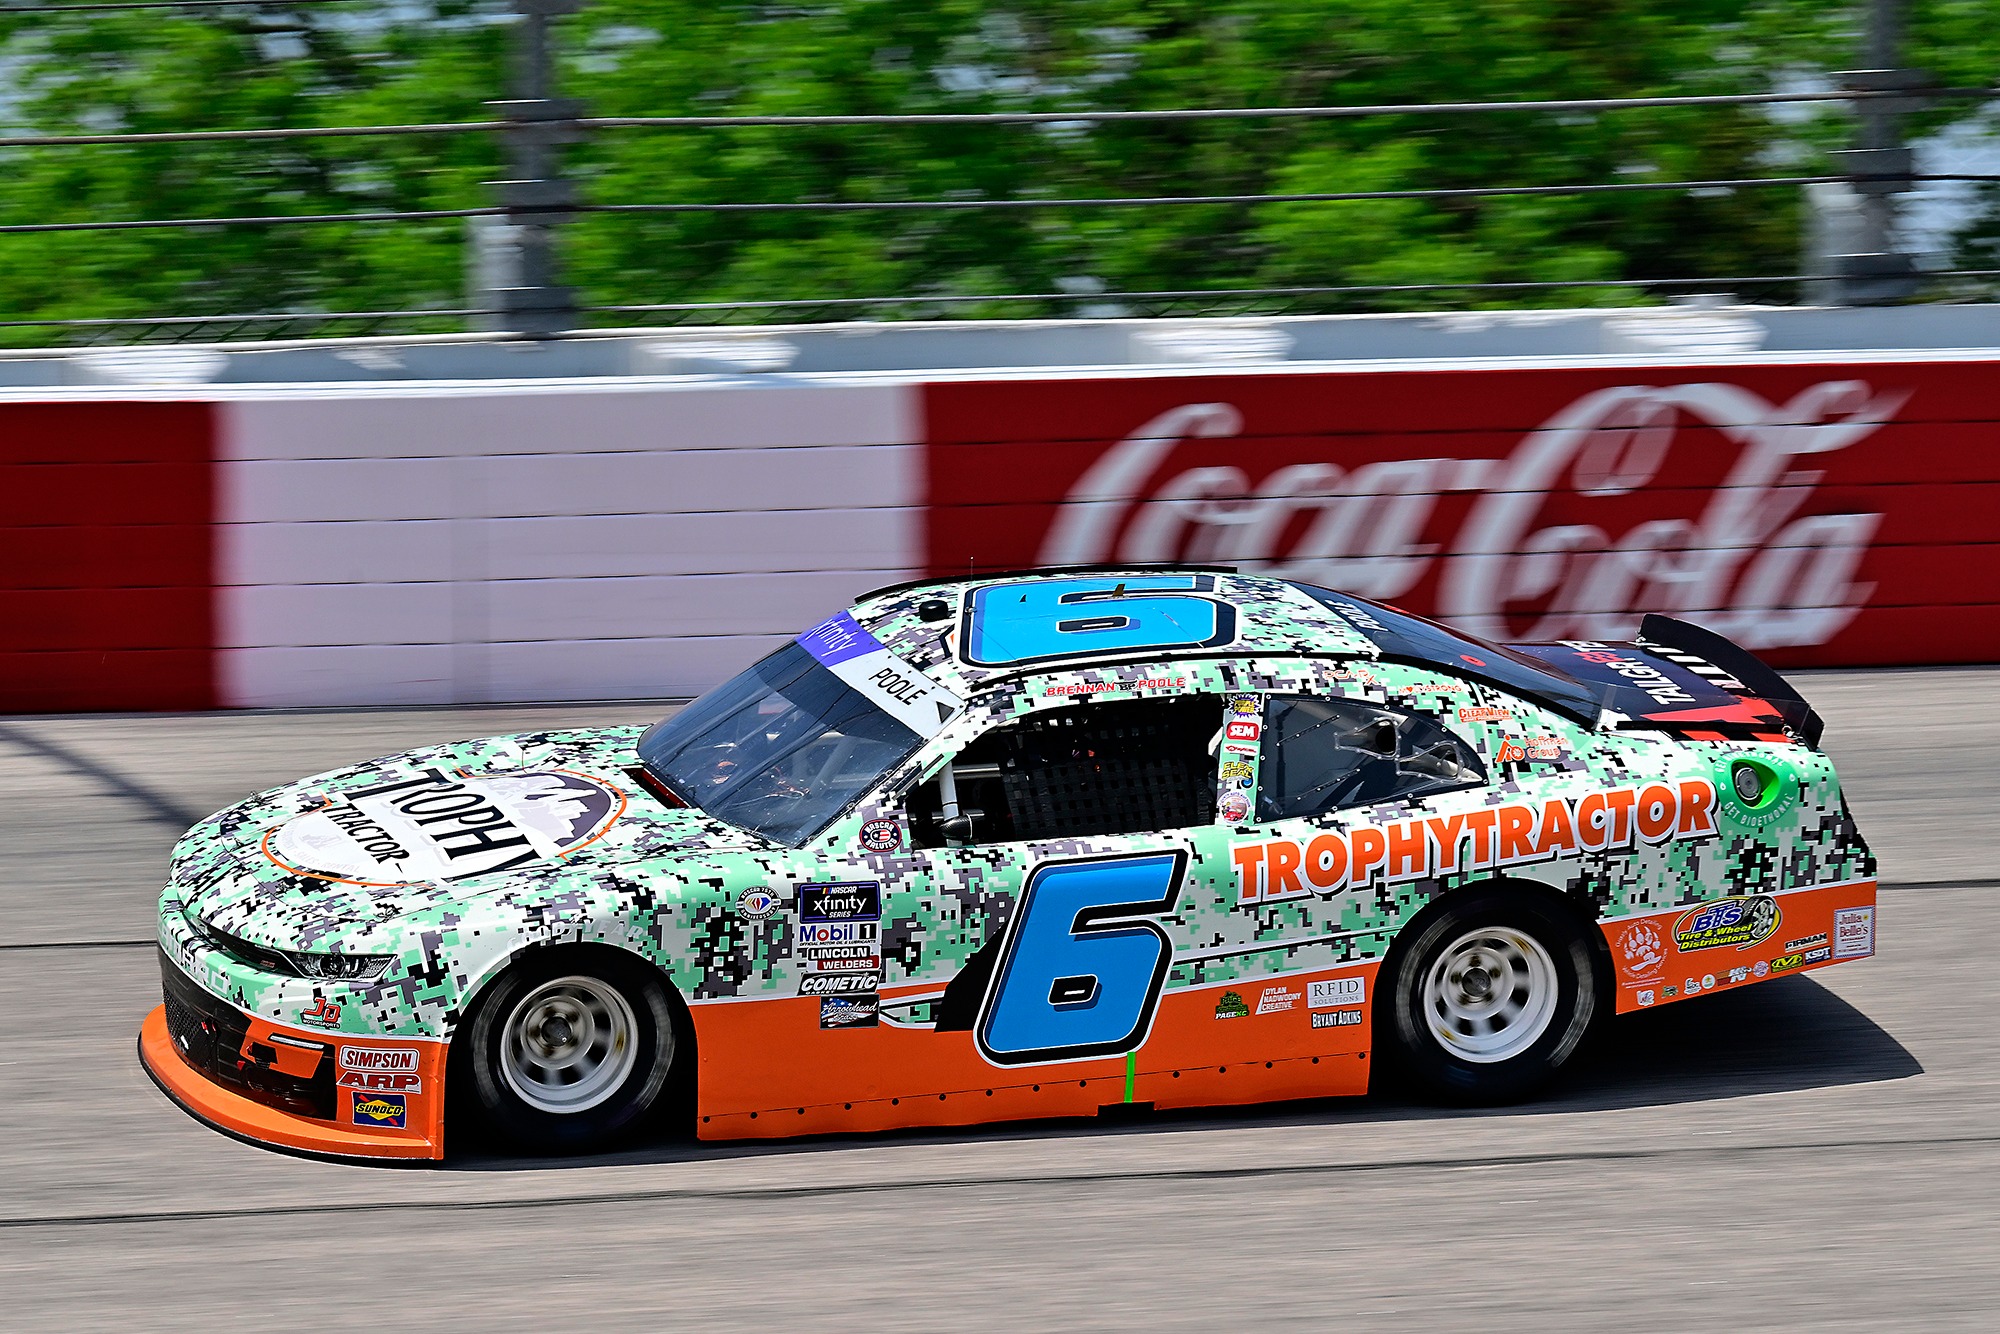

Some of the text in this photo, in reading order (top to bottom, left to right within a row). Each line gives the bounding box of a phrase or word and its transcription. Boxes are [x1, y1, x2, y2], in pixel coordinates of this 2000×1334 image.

[805, 617, 857, 657] xfinity
[868, 667, 929, 706] POOLE
[1046, 682, 1116, 697] BRENNAN
[1138, 677, 1187, 689] POOLE
[1229, 724, 1256, 738] SEM
[1523, 735, 1569, 747] Hoffman
[1527, 747, 1562, 759] Group
[1222, 760, 1255, 772] FLEX
[1221, 769, 1253, 780] SEAL
[1724, 801, 1741, 819] GET
[341, 767, 555, 883] TROPHY
[863, 821, 896, 834] NASCAR
[321, 802, 412, 866] TRACTOR
[1232, 779, 1714, 902] TROPHYTRACTOR
[865, 837, 898, 850] SALUTES
[830, 886, 858, 894] NASCAR
[813, 894, 867, 916] xfinity
[828, 911, 852, 919] SERIES
[1839, 913, 1863, 925] Julia
[799, 923, 854, 942] Mobil
[1680, 924, 1753, 941] Tire & Wheel
[1680, 934, 1751, 950] Distributors
[810, 947, 868, 960] LINCOLN
[974, 847, 1191, 1068] 6
[822, 959, 874, 970] WELDERS
[801, 975, 878, 992] COMETIC
[1265, 986, 1287, 996] DYLAN
[1313, 980, 1360, 997] RFID
[820, 1000, 879, 1014] Arrowhead
[1261, 1000, 1294, 1011] CREATIVE
[1313, 995, 1360, 1006] SOLUTIONS
[303, 997, 341, 1023] JD
[302, 1018, 341, 1029] MOTORSPORTS
[1311, 1010, 1362, 1029] BRYANT ADKINS
[345, 1050, 413, 1069] SIMPSON
[339, 1071, 420, 1090] ARP
[357, 1103, 404, 1116] SUNOCO
